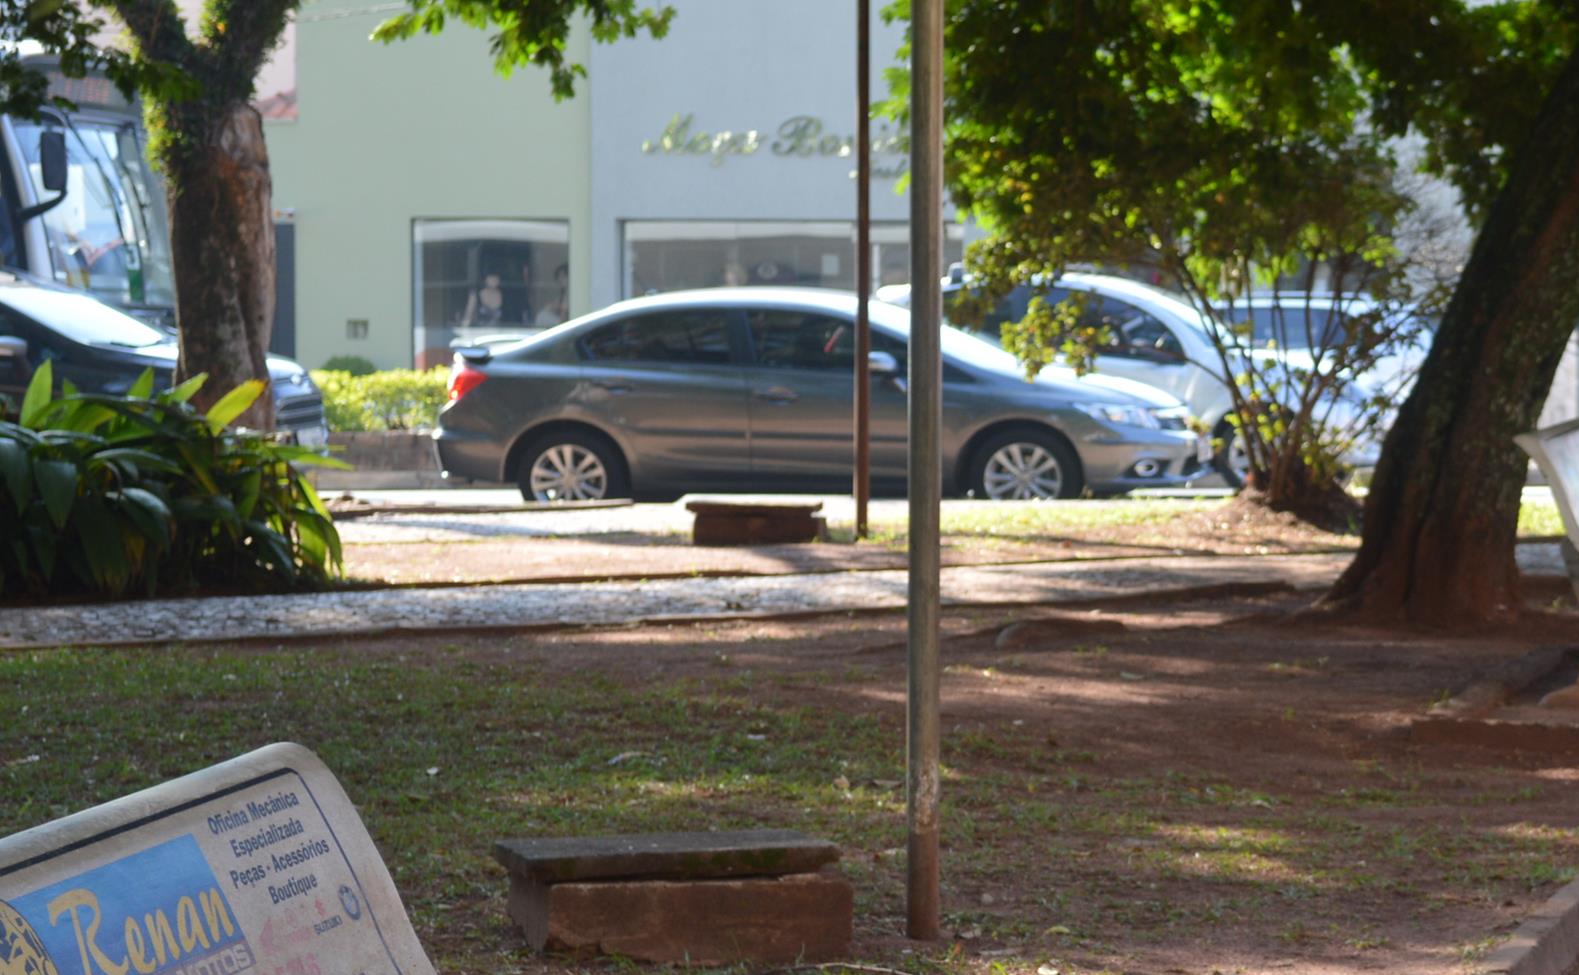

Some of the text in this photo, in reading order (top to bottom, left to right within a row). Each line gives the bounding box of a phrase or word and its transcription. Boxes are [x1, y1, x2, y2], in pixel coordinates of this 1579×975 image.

[207, 792, 299, 835] Oficina Mecânica
[230, 817, 304, 858] Especializada
[230, 839, 330, 889] Peças Acessórios
[268, 872, 318, 904] Boutique
